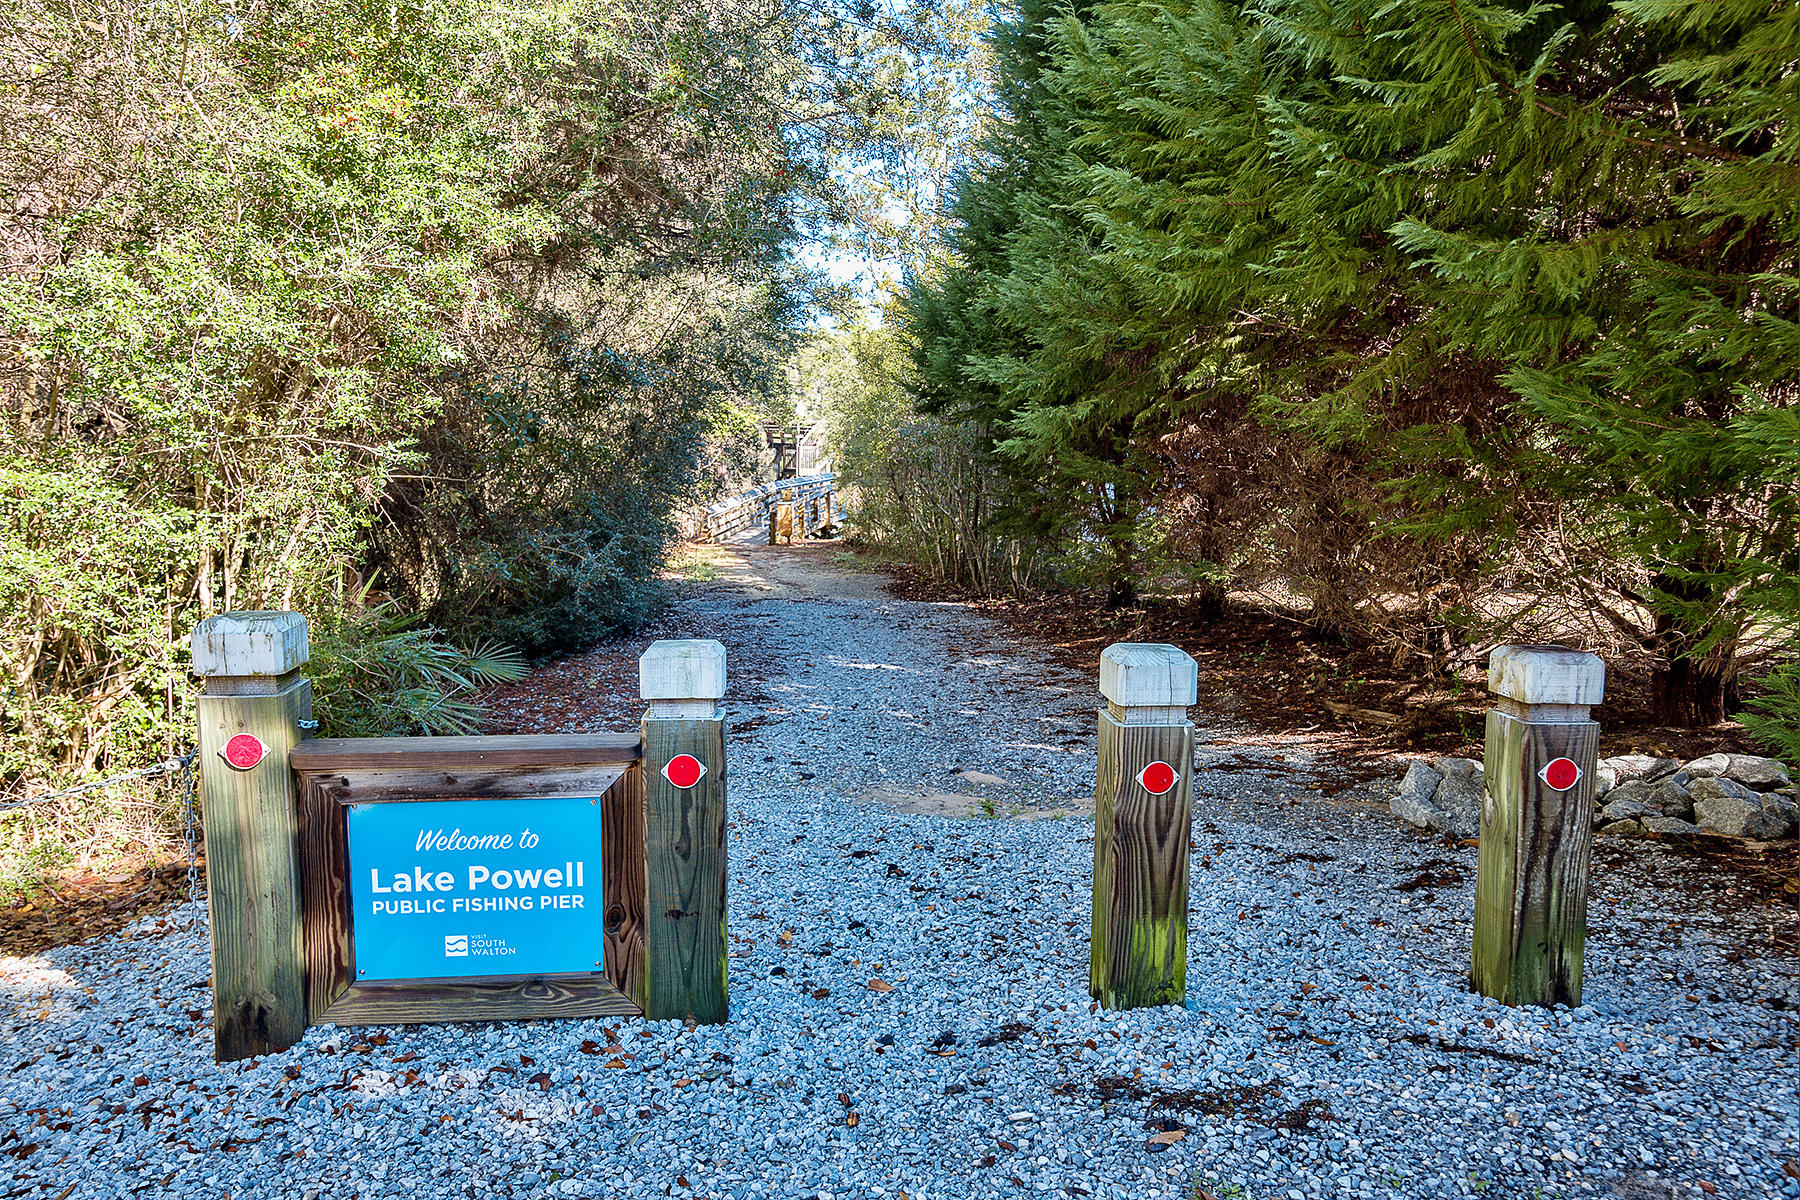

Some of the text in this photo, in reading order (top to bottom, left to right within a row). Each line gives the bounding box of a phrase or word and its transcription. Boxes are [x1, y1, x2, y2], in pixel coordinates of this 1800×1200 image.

[415, 827, 540, 852] Welcome to
[370, 861, 584, 893] Lake Powell
[372, 894, 585, 915] PUBLIC FISHING PIER
[471, 939, 506, 948] SOUTH
[471, 947, 516, 956] WALTON
